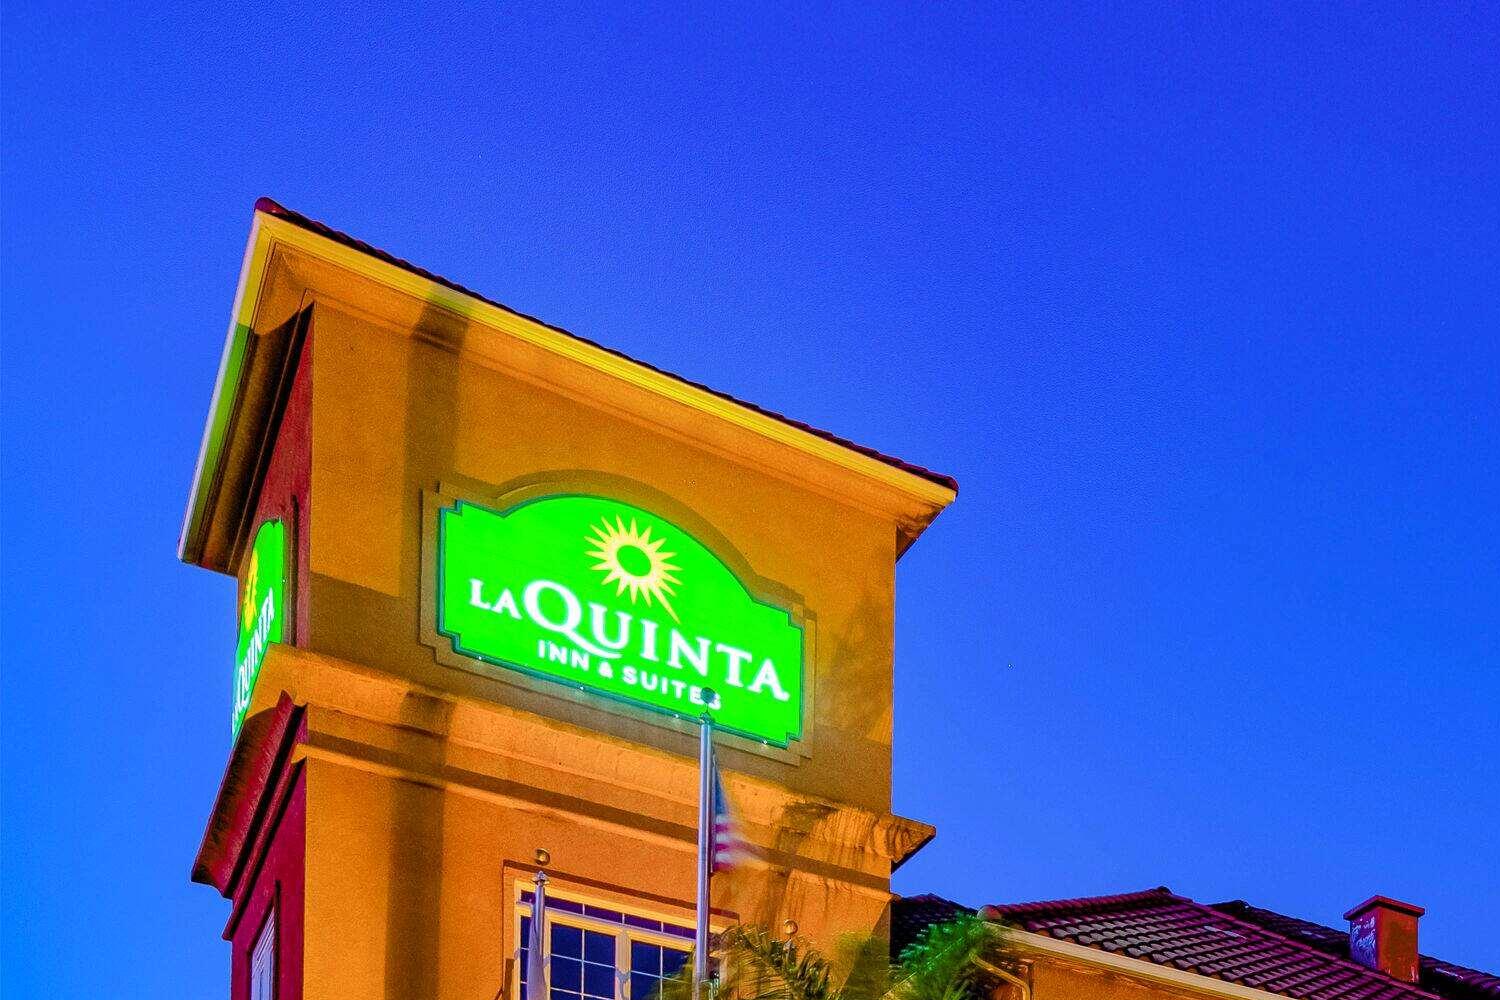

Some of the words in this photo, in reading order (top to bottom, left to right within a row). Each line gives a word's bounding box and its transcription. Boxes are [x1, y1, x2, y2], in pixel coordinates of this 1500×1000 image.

[469, 578, 523, 620] LA
[522, 579, 791, 701] QUINTA
[537, 639, 590, 672] INN
[598, 661, 614, 679] &
